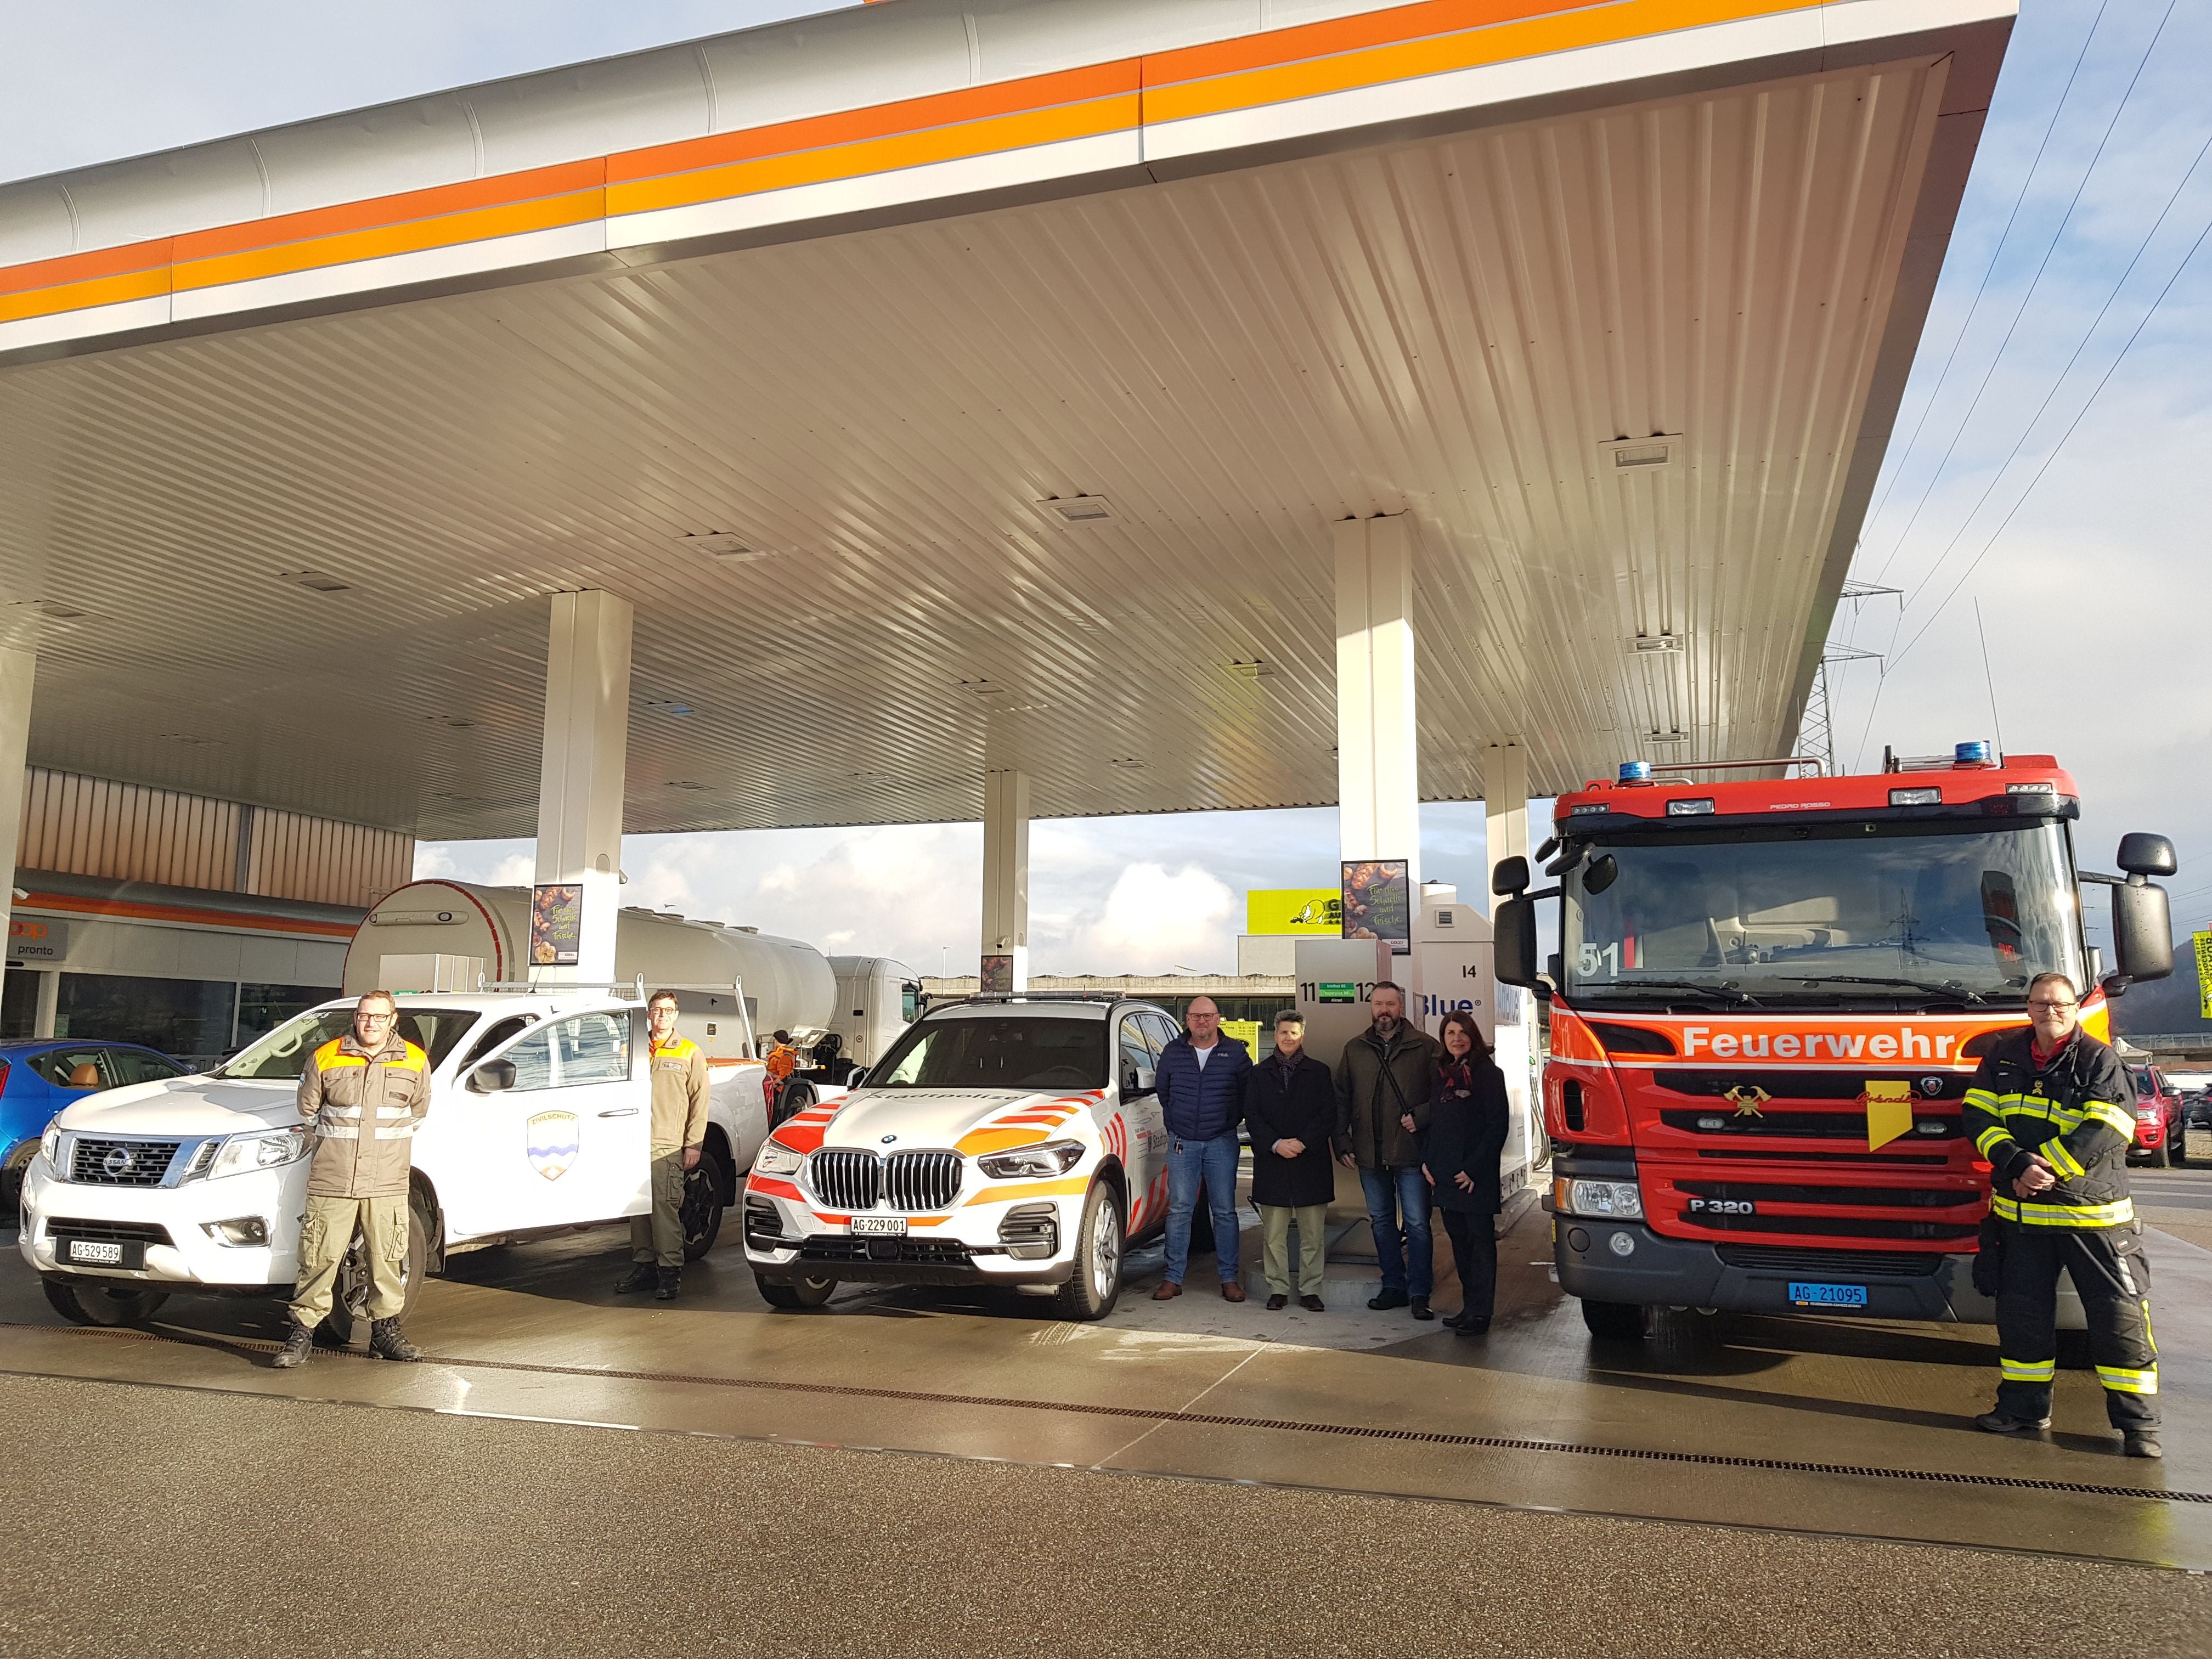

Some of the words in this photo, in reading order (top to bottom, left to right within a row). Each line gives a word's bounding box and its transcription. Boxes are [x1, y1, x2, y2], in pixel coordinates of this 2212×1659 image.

[1367, 884, 1381, 895] Für
[1328, 899, 1341, 911] G
[1380, 902, 1393, 913] und
[18, 946, 53, 955] pronto
[1577, 942, 1618, 977] 51
[1300, 982, 1315, 1002] 11
[1356, 982, 1375, 1002] 12
[1683, 1027, 1955, 1058] Feuerwehr
[532, 1114, 575, 1125] ZIVILSCHUTZ
[1691, 1200, 1705, 1211] P
[1709, 1200, 1753, 1214] 320
